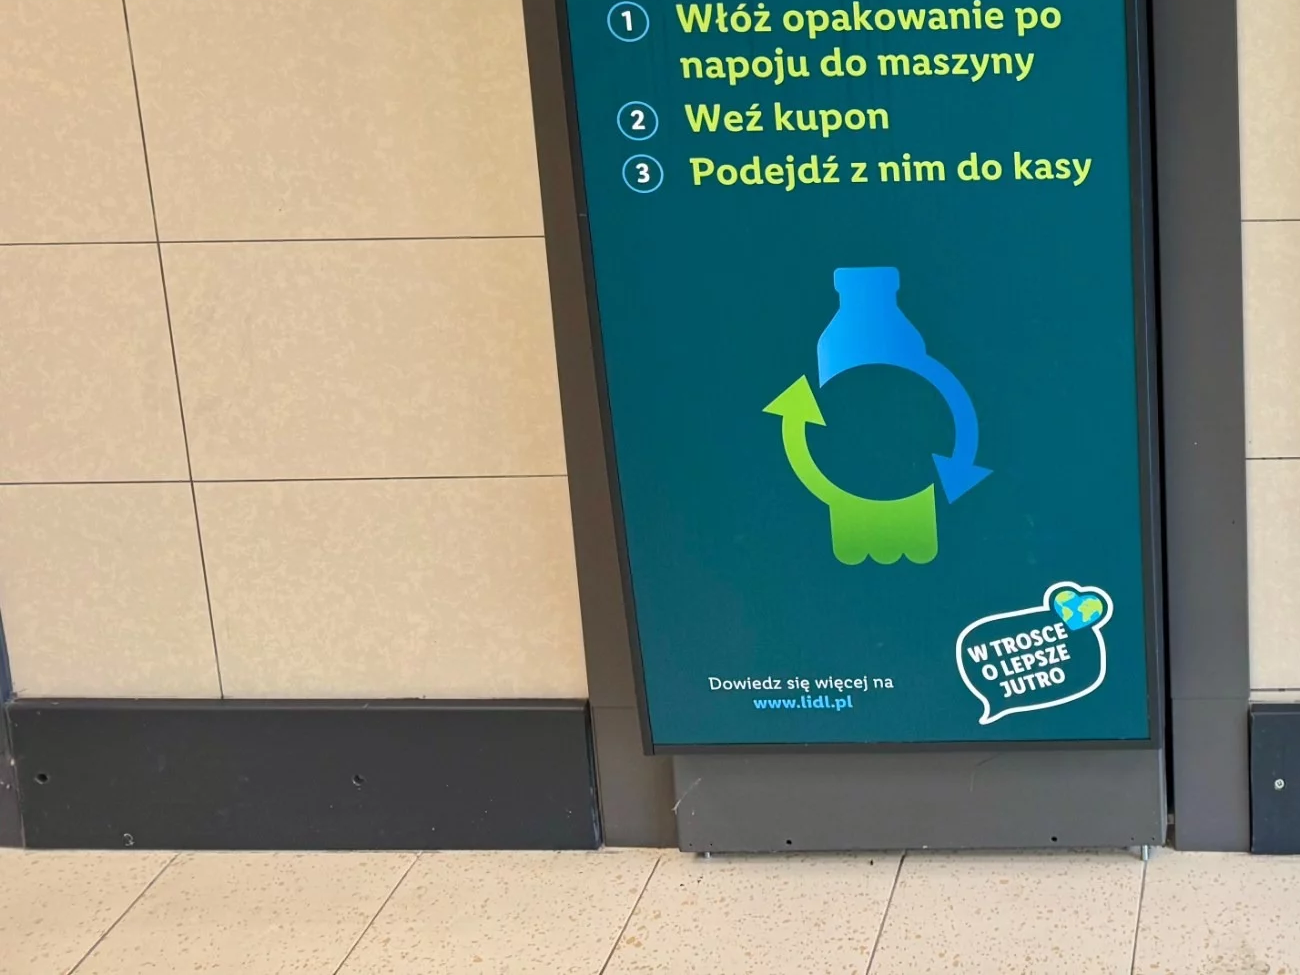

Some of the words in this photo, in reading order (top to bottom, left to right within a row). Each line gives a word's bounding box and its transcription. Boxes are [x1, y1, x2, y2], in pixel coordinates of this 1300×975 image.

[622, 11, 632, 31] 1
[676, 3, 771, 33] Włóż
[783, 0, 1004, 39] opakowanie
[1015, 7, 1061, 36] po
[680, 49, 810, 85] napoju
[820, 49, 866, 77] do
[878, 53, 1034, 82] maszyny
[631, 111, 645, 129] 2
[685, 103, 763, 132] Weź
[774, 102, 888, 137] kupon
[636, 163, 650, 183] 3
[690, 155, 840, 191] Podejdź
[851, 163, 868, 183] z
[878, 153, 945, 181] nim
[958, 153, 1002, 181] do
[1014, 152, 1092, 186] kasy
[967, 643, 988, 663] W
[989, 622, 1069, 658] TROSCE
[982, 664, 998, 681] O
[999, 643, 1071, 677] LEPSZE
[708, 677, 782, 690] Dowiedz
[787, 677, 809, 692] się
[815, 676, 868, 692] więcej
[873, 679, 894, 688] na
[999, 667, 1066, 698] JUTRO
[754, 695, 853, 711] www.lidl.pl
